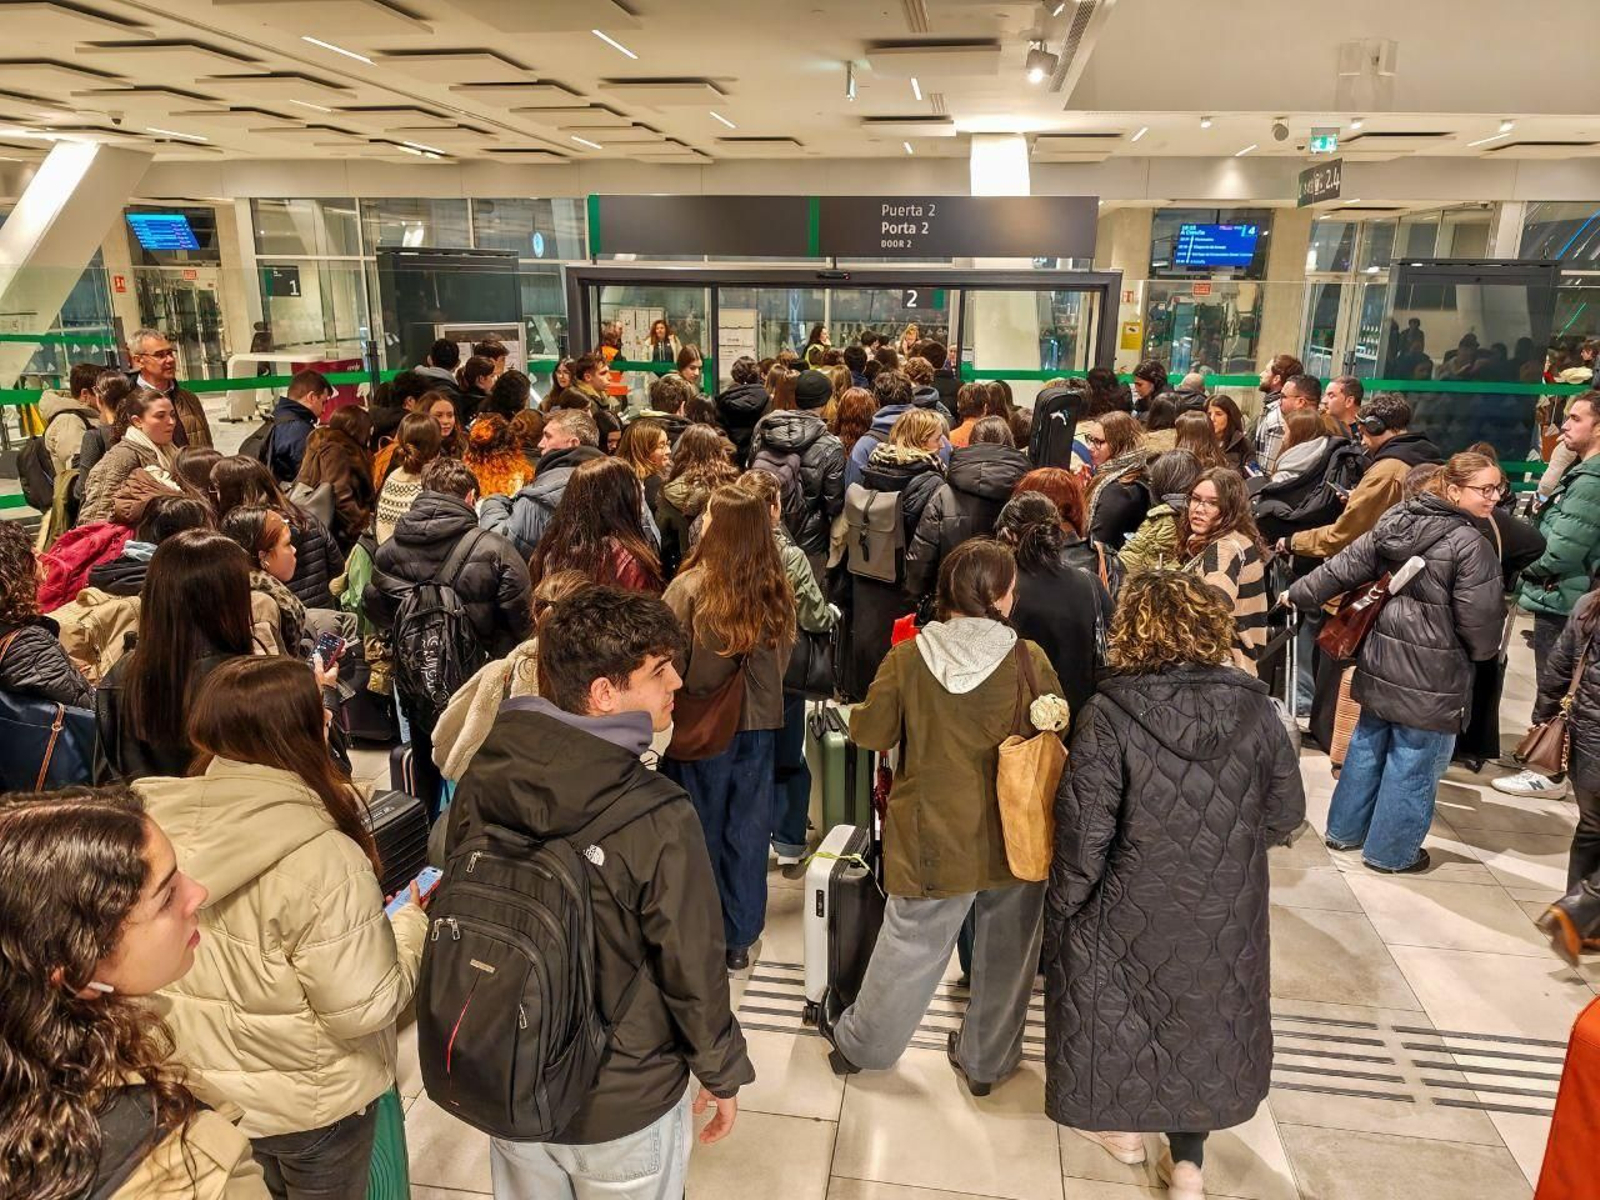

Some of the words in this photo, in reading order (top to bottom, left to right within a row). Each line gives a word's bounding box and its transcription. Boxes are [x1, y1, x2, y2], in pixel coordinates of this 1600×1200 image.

[881, 204, 923, 217] Puerta
[928, 204, 936, 217] 2
[881, 221, 916, 234] Porta
[921, 221, 929, 234] 2
[1248, 226, 1255, 234] 4
[290, 280, 299, 295] 1
[907, 290, 917, 307] 2
